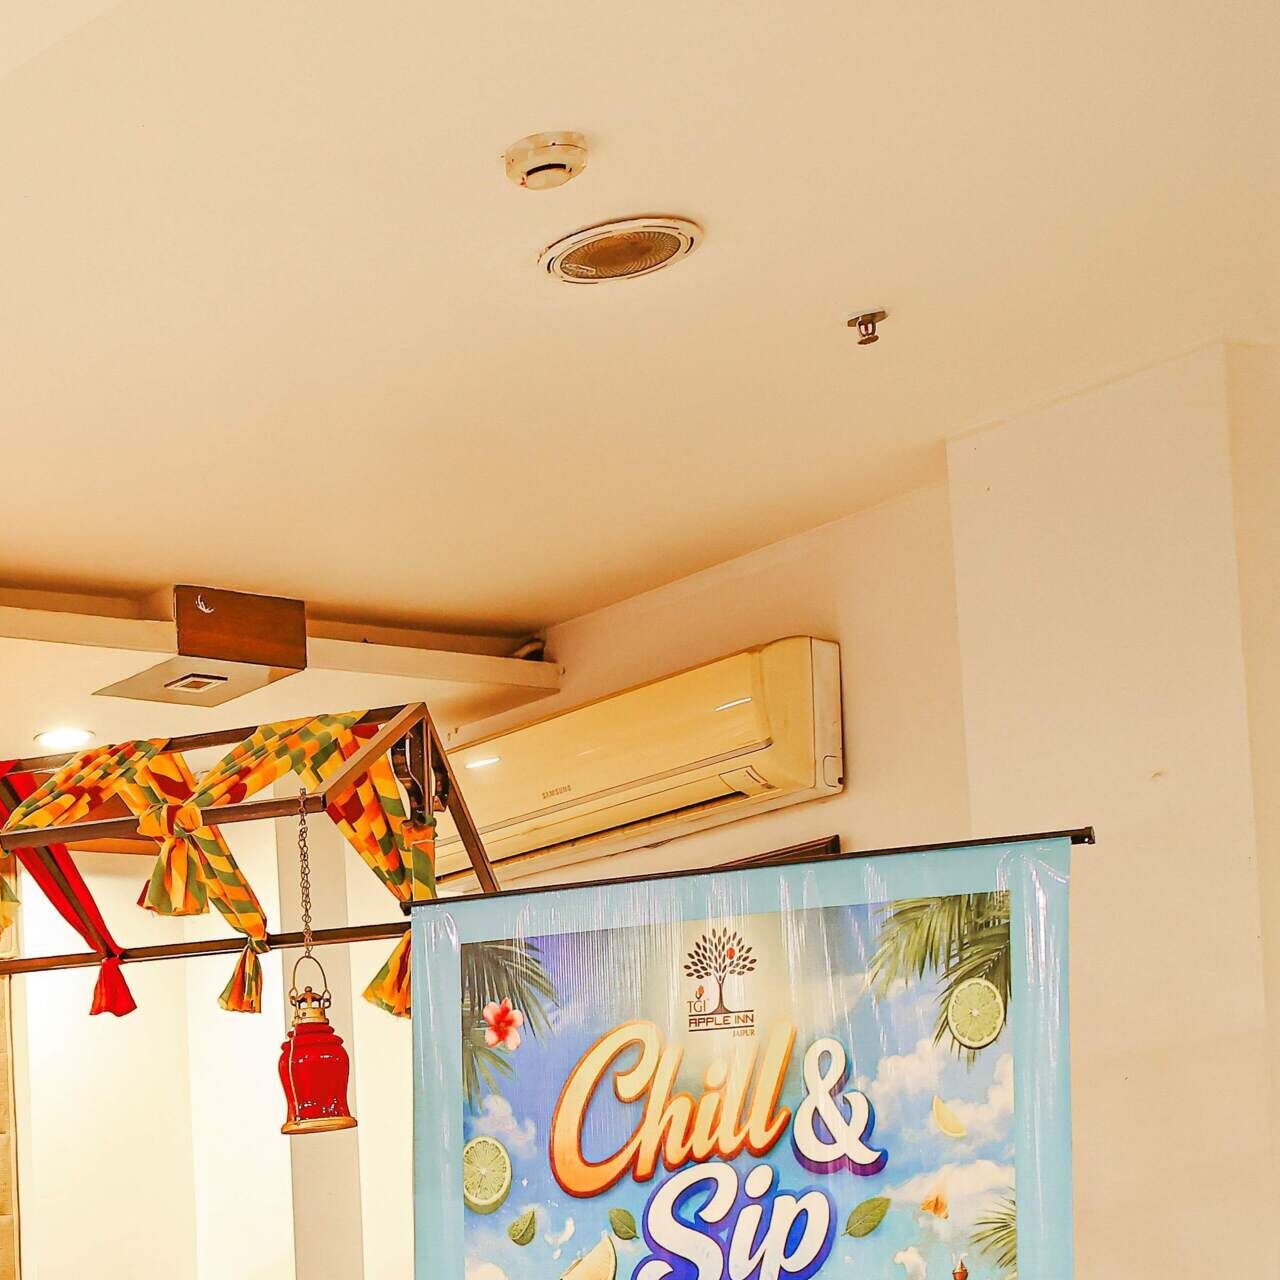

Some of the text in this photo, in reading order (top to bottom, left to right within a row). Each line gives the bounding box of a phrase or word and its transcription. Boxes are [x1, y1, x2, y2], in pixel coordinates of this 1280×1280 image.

[687, 1000, 706, 1013] TGI
[689, 1013, 754, 1028] APPLE INN
[550, 1021, 888, 1198] Chill &
